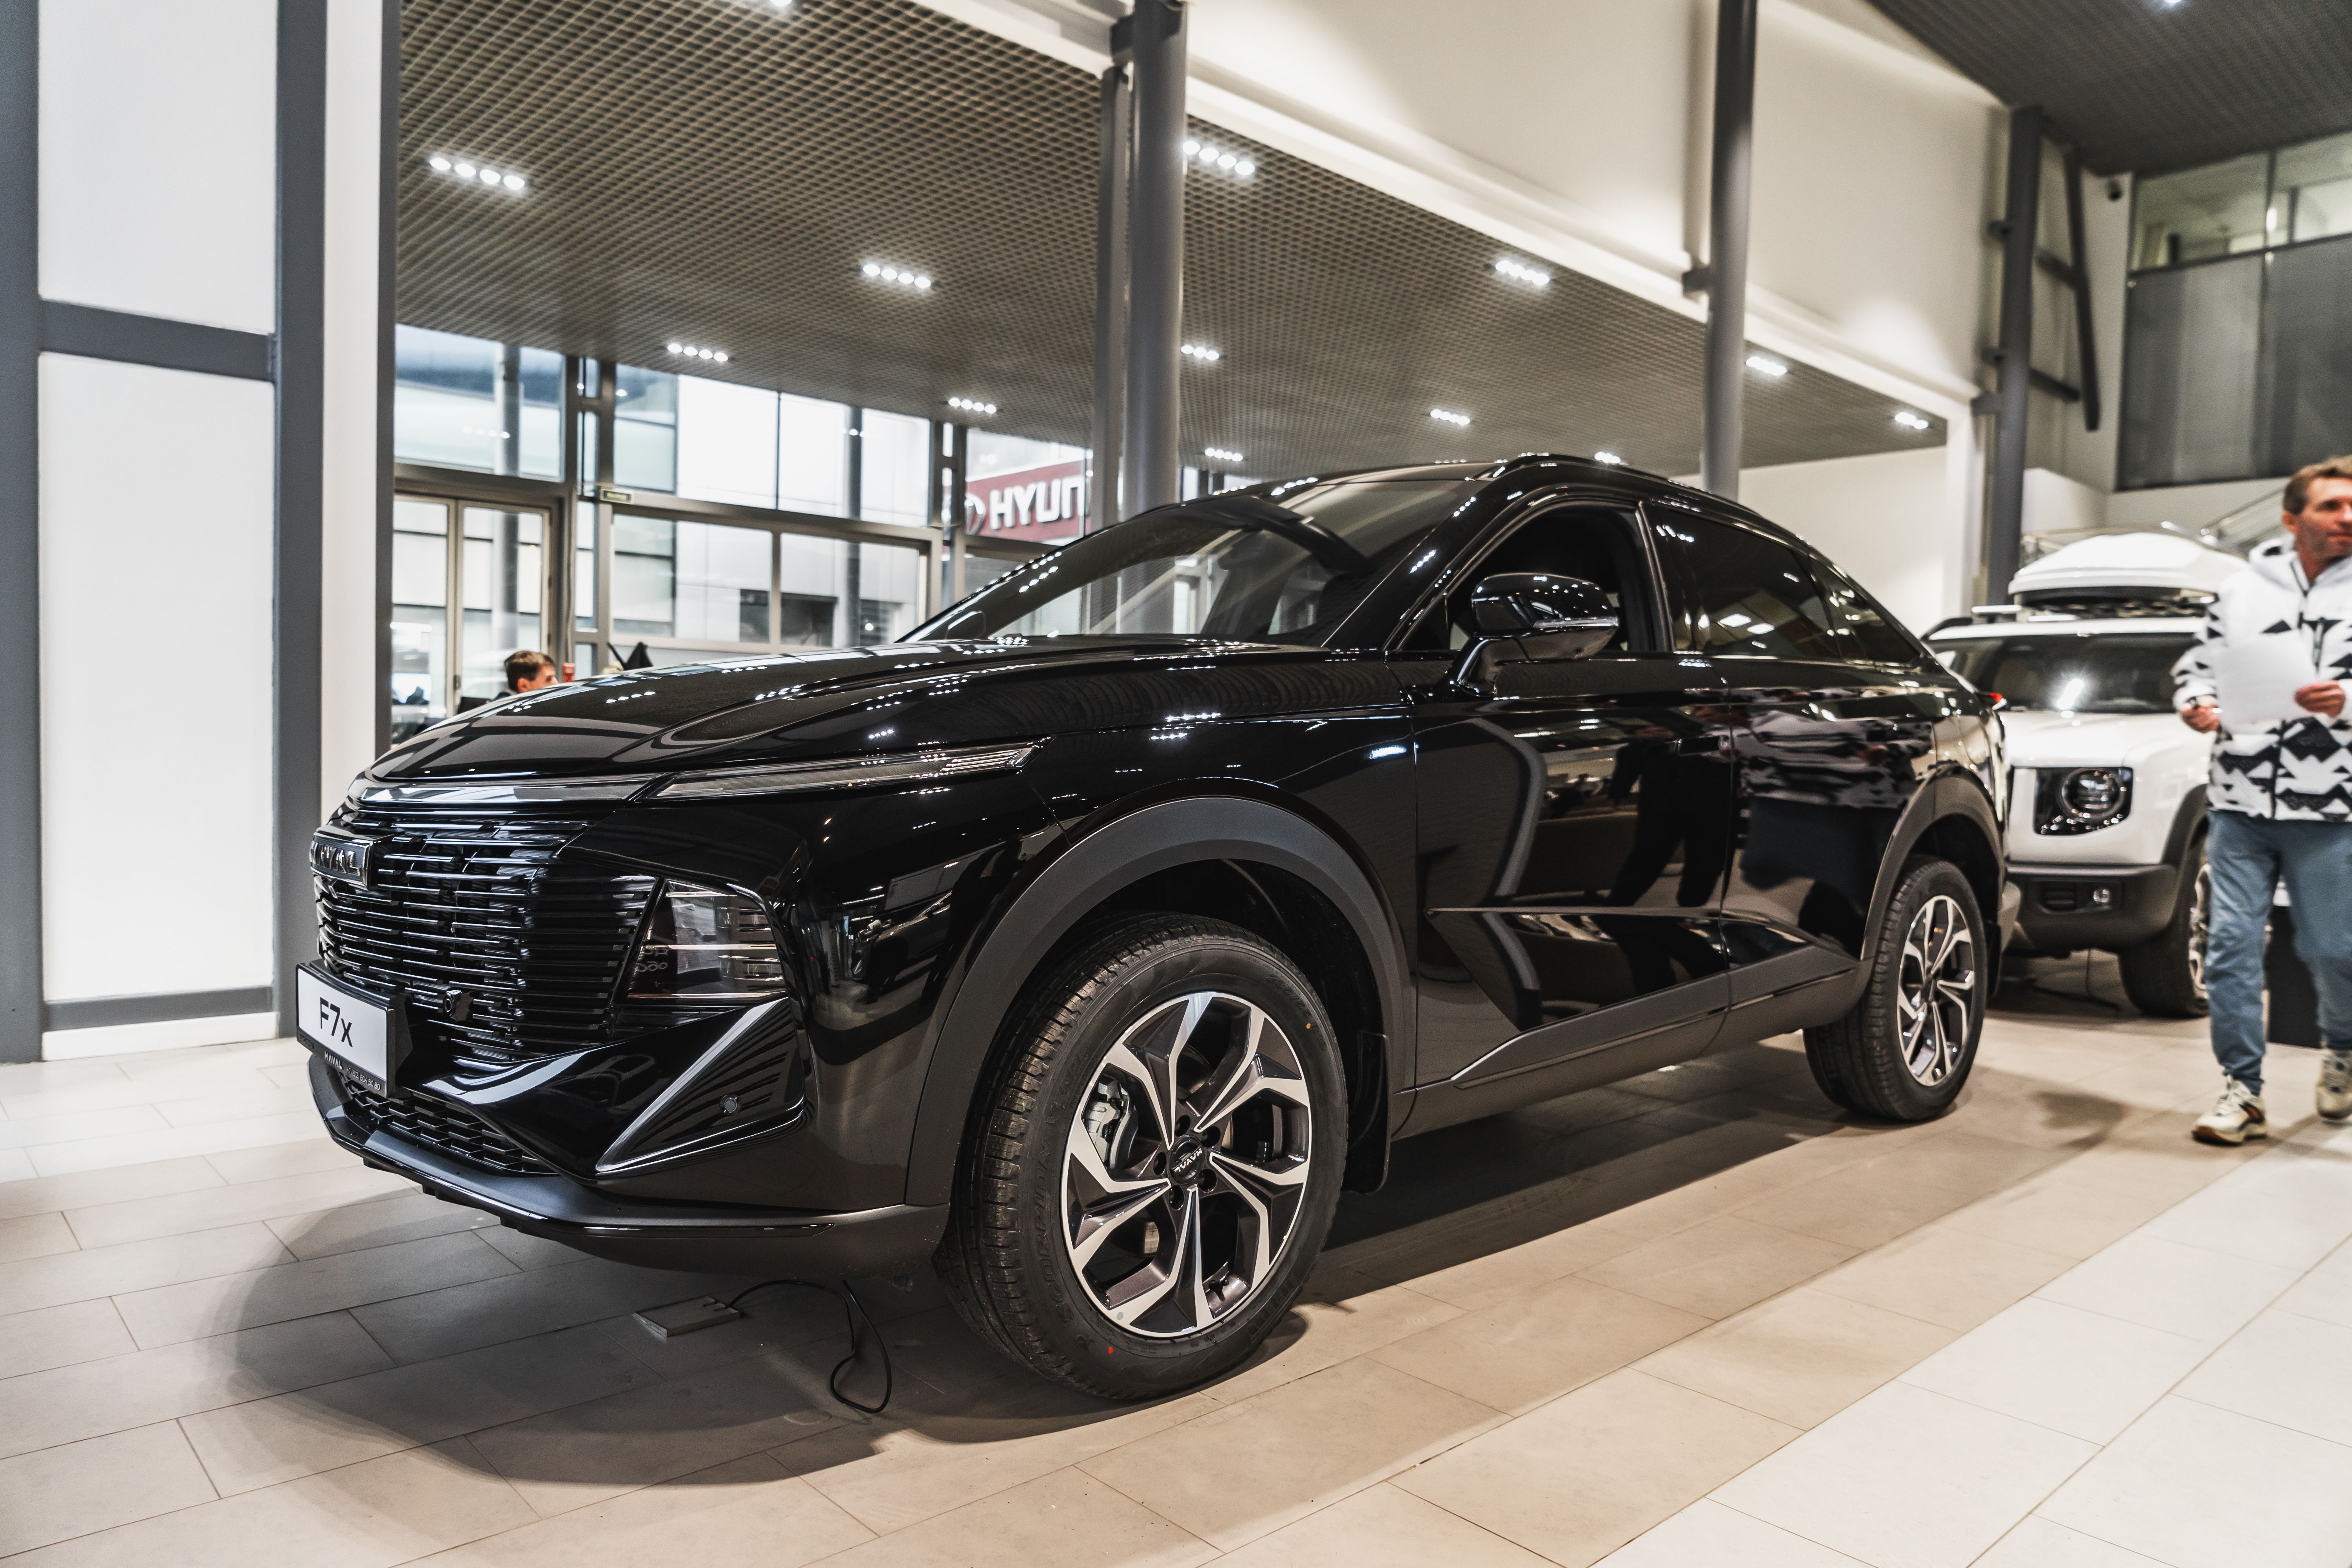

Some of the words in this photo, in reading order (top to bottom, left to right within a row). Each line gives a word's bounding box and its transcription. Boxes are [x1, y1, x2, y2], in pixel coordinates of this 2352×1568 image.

[989, 475, 1091, 530] HYUN
[320, 997, 353, 1047] F7x
[325, 1051, 343, 1070] HAVAL
[374, 1082, 381, 1091] 80
[1174, 1148, 1202, 1172] HAVAL
